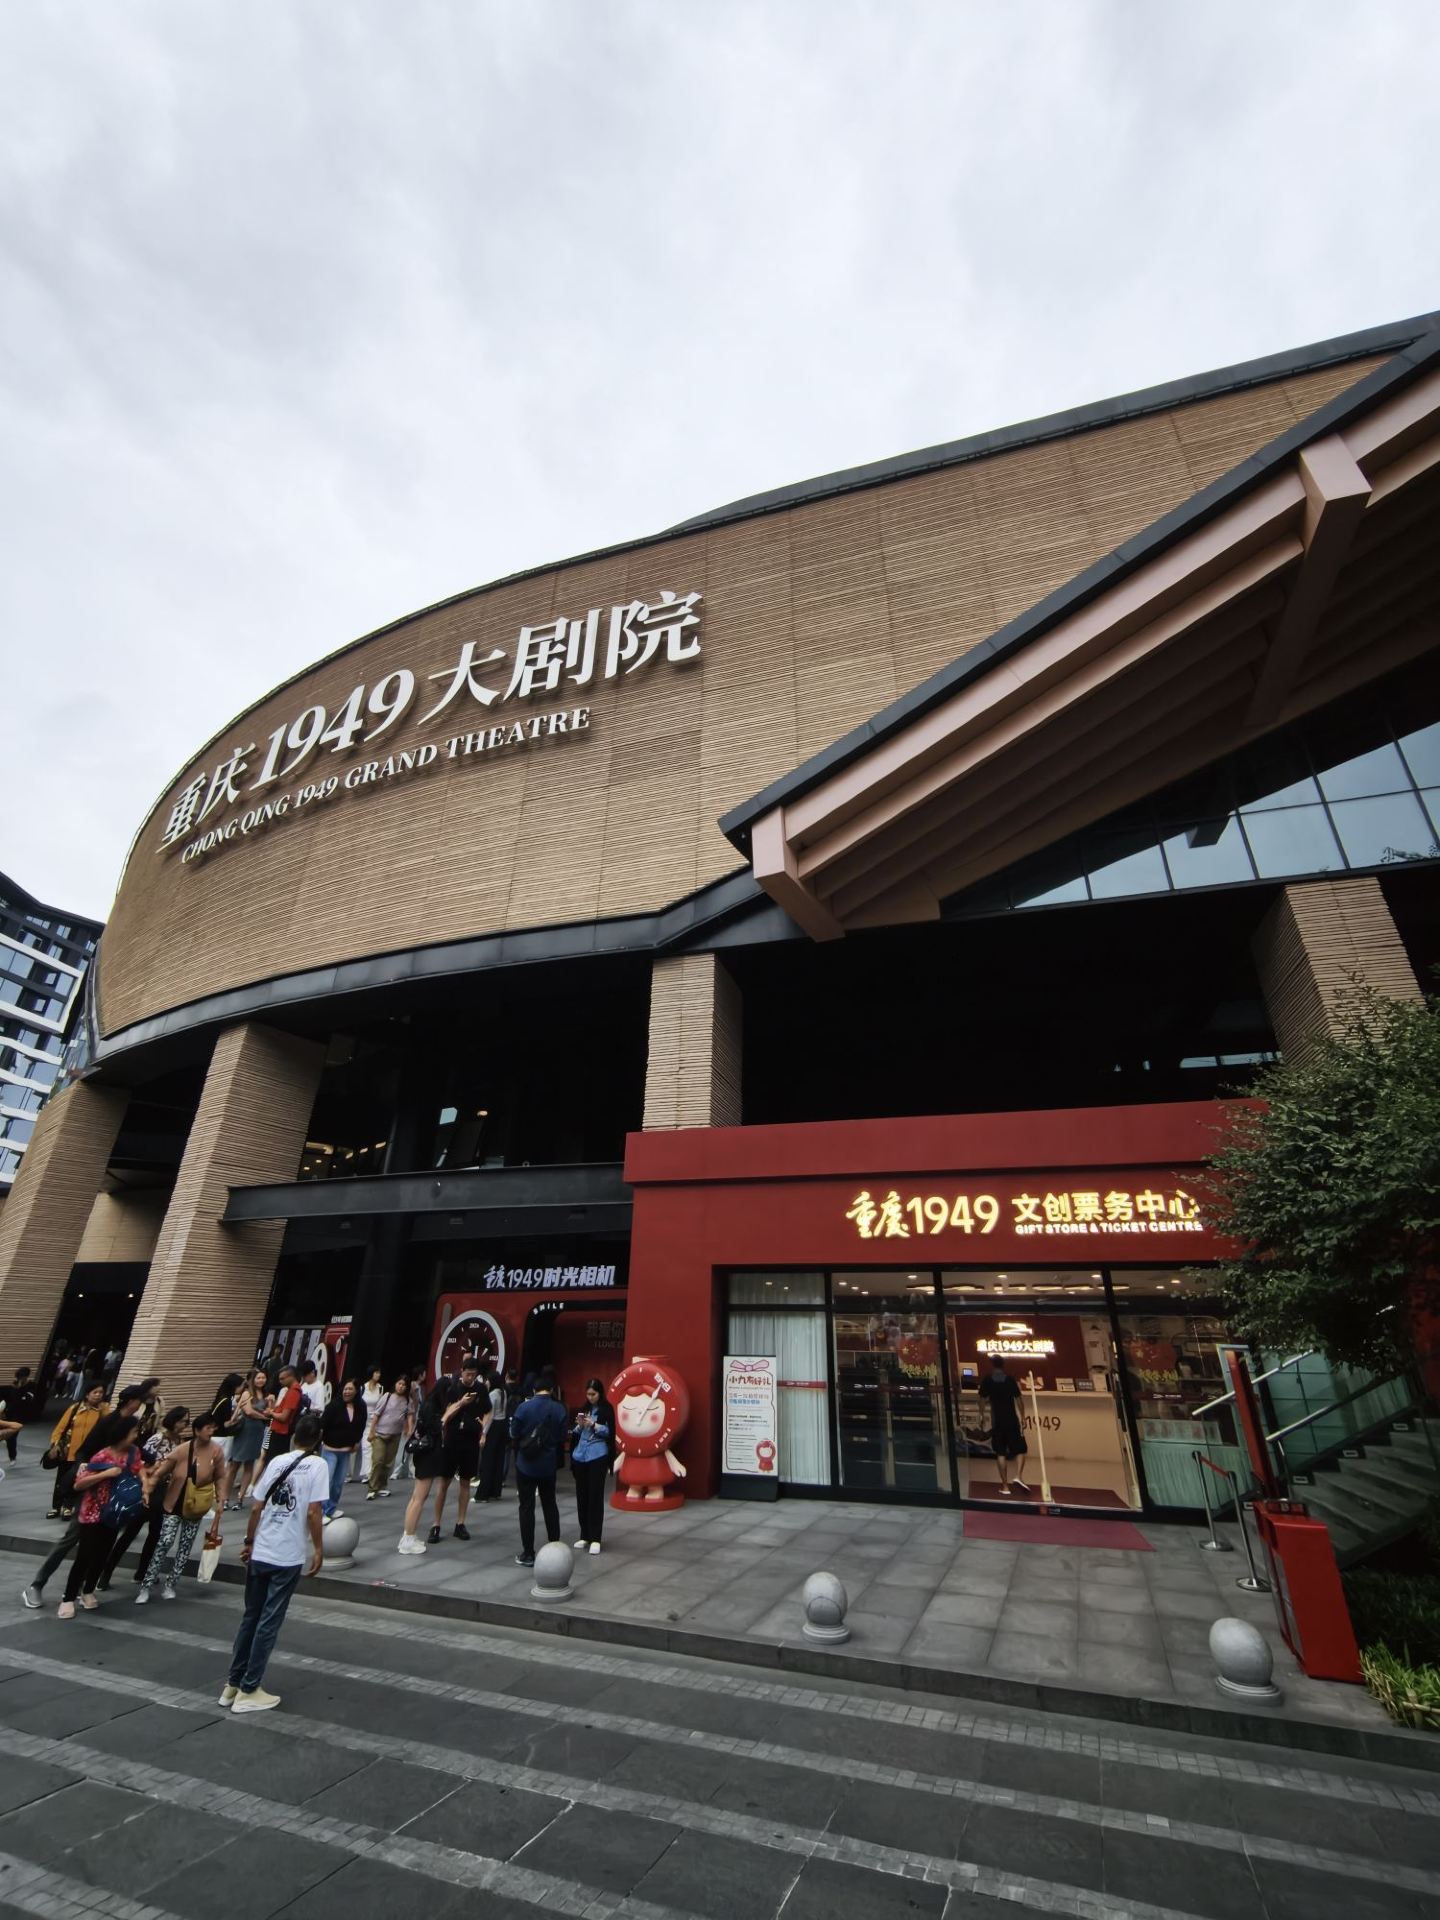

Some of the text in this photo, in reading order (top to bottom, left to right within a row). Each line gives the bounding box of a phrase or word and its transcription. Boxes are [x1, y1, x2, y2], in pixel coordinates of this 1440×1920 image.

[155, 591, 702, 854] 重庆1949大剧院
[181, 706, 590, 864] CHONG QING 1949 GRAND THEATRE
[1011, 1188, 1201, 1223] 文创票务中心
[1015, 1220, 1203, 1235] GIFT STORE & TICKET CENTRE
[533, 1302, 565, 1315] SMILE
